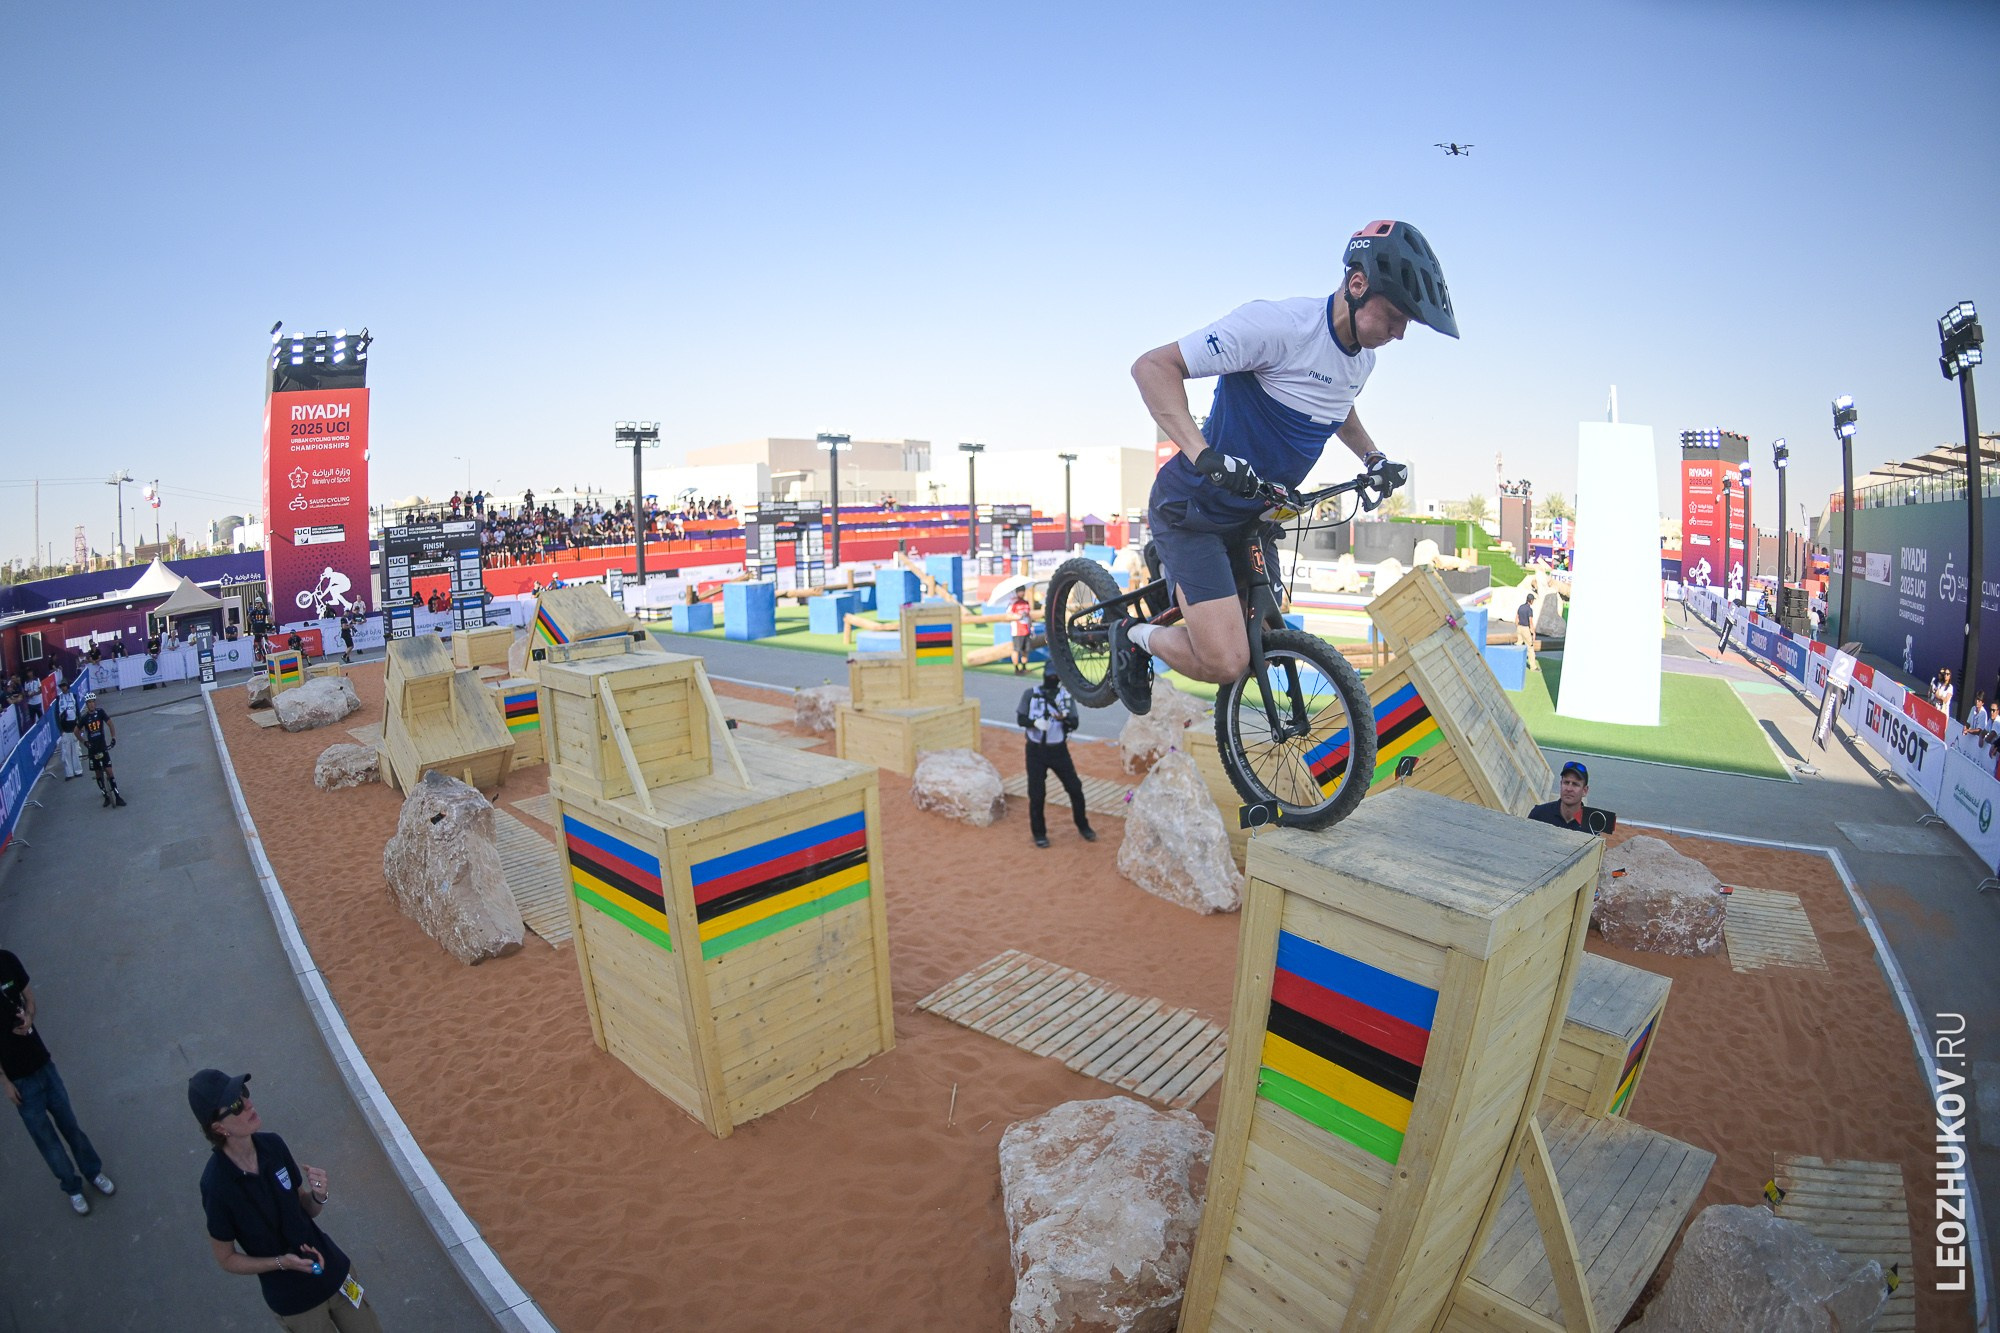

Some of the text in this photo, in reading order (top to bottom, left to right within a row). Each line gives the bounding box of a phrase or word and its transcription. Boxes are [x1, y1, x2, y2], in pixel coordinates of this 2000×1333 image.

[1308, 370, 1333, 384] FINLAND
[291, 403, 351, 421] RIYADH
[291, 421, 350, 435] 2025 UCI
[290, 442, 350, 452] CHAMPIONSHIPS
[312, 467, 351, 478] وزارة الرياضة
[1688, 468, 1713, 477] RIYADH
[297, 528, 310, 536] UCI
[393, 528, 407, 536] UCI
[423, 541, 445, 551] FINISH
[392, 557, 406, 565] UCI
[1900, 547, 1927, 573] RIYADH
[1282, 565, 1312, 578] UCI
[613, 580, 620, 591] 2
[1900, 575, 1927, 599] 2025 UCI
[1957, 575, 2000, 598] SAU CLING
[197, 631, 211, 639] START
[397, 629, 411, 637] UCI
[202, 637, 208, 650] 1
[1835, 657, 1850, 678] 2
[88, 720, 101, 732] ESP
[1881, 708, 1929, 773] TISSOT
